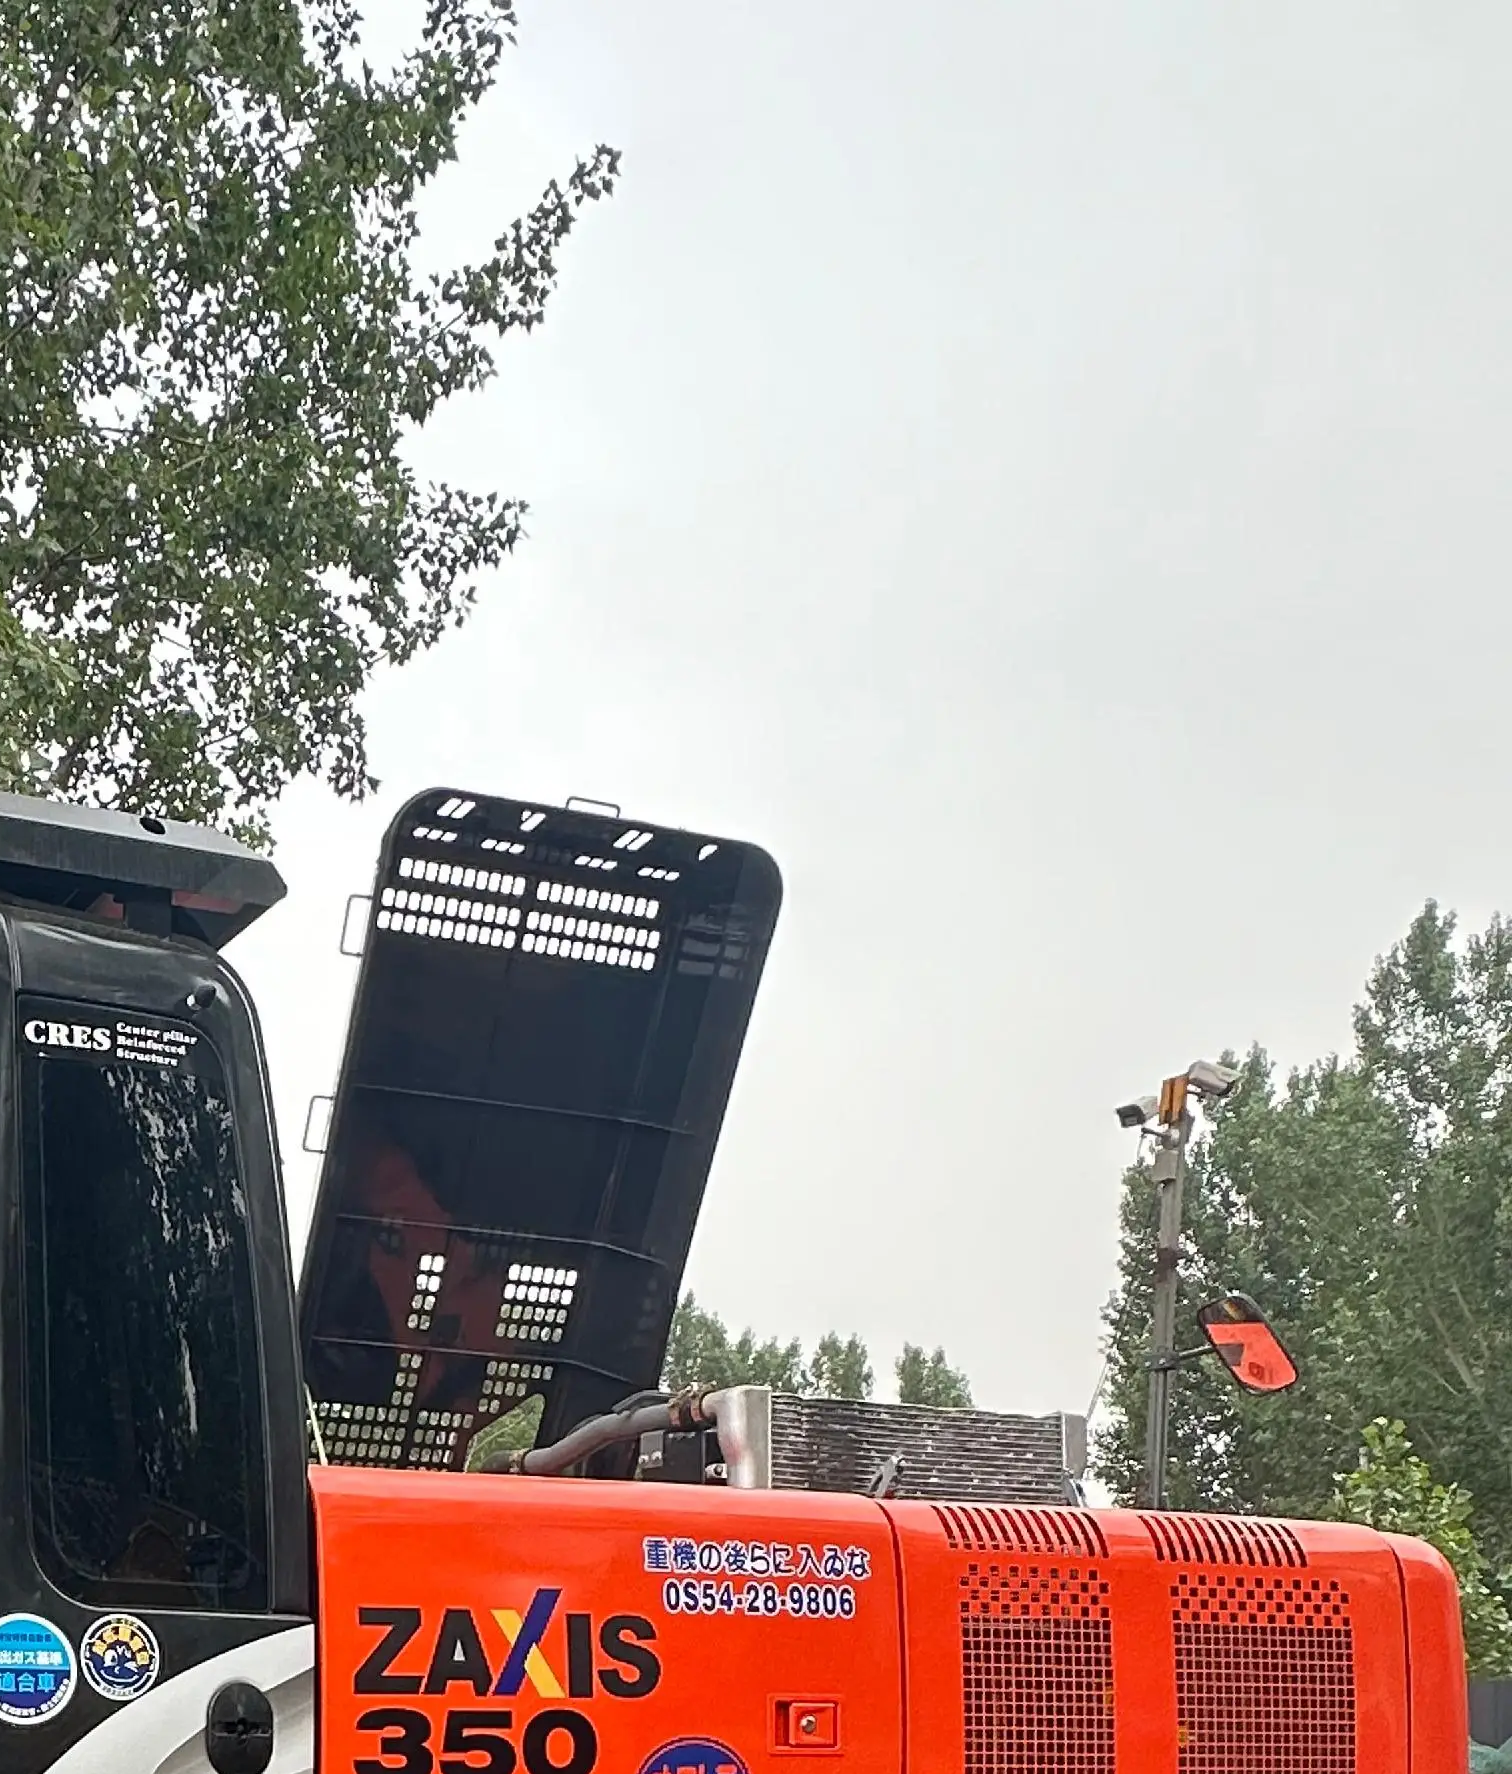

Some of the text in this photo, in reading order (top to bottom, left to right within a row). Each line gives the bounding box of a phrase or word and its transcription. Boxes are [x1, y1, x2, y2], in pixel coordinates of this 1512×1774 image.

[24, 1020, 112, 1051] CRES
[116, 1021, 198, 1045] Center pillar
[116, 1035, 187, 1055] Reinforced
[116, 1047, 179, 1067] Structure
[352, 1587, 662, 1699] ZAXIS
